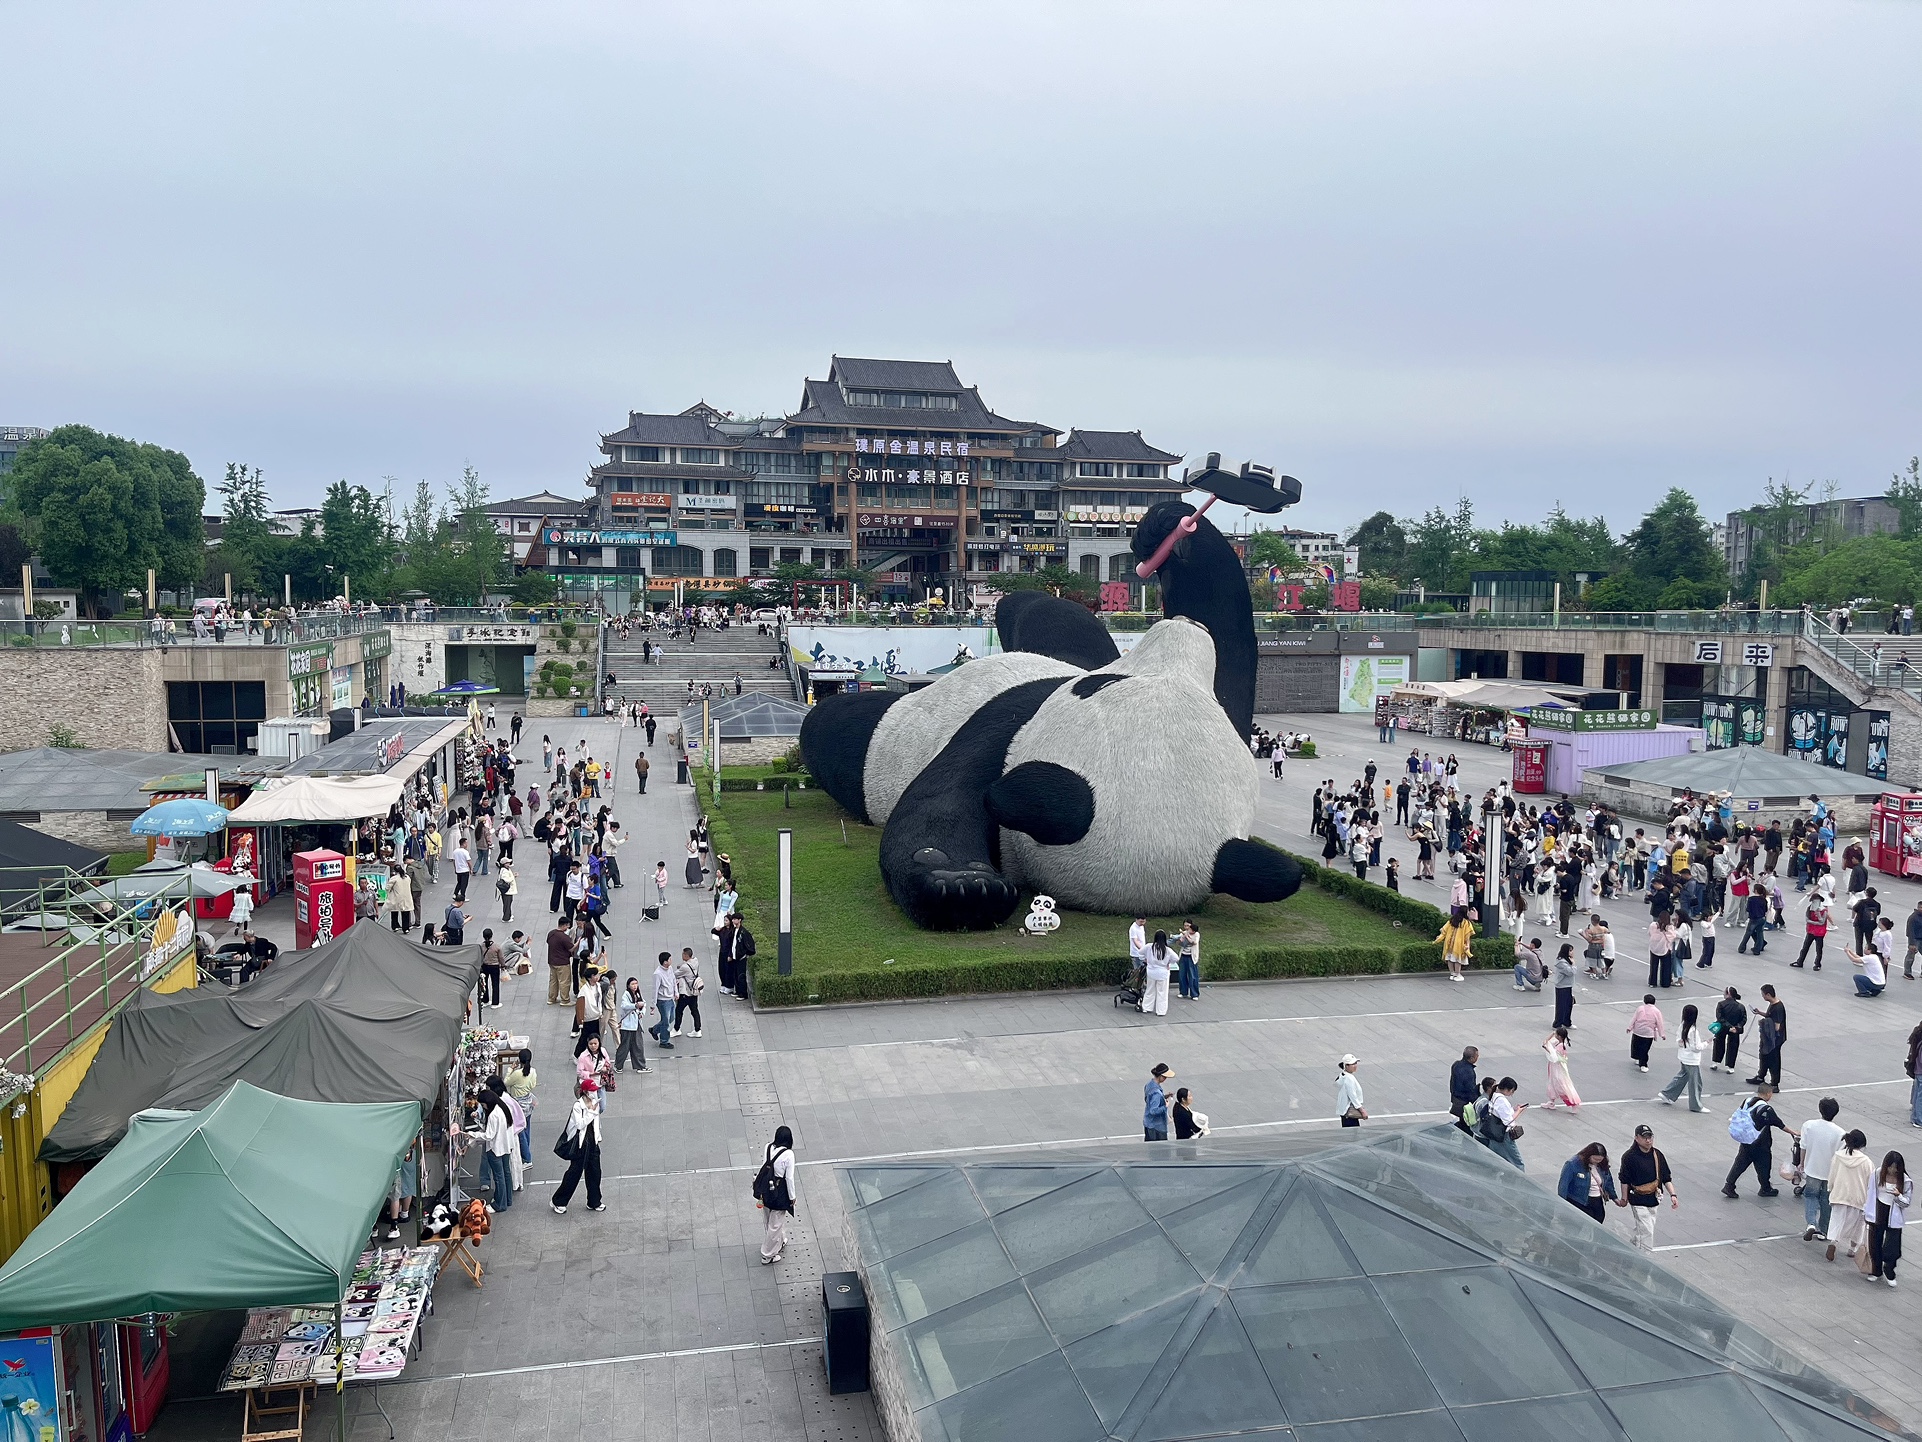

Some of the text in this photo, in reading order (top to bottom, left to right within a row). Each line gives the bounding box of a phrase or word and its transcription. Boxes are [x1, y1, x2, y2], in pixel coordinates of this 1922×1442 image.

[855, 439, 969, 456] 璞原舍温泉民宿
[1100, 581, 1130, 611] 源
[1696, 642, 1771, 665] 后来
[1531, 709, 1573, 724] 花花熊猫家园
[1583, 711, 1651, 724] 花花熊猫家园
